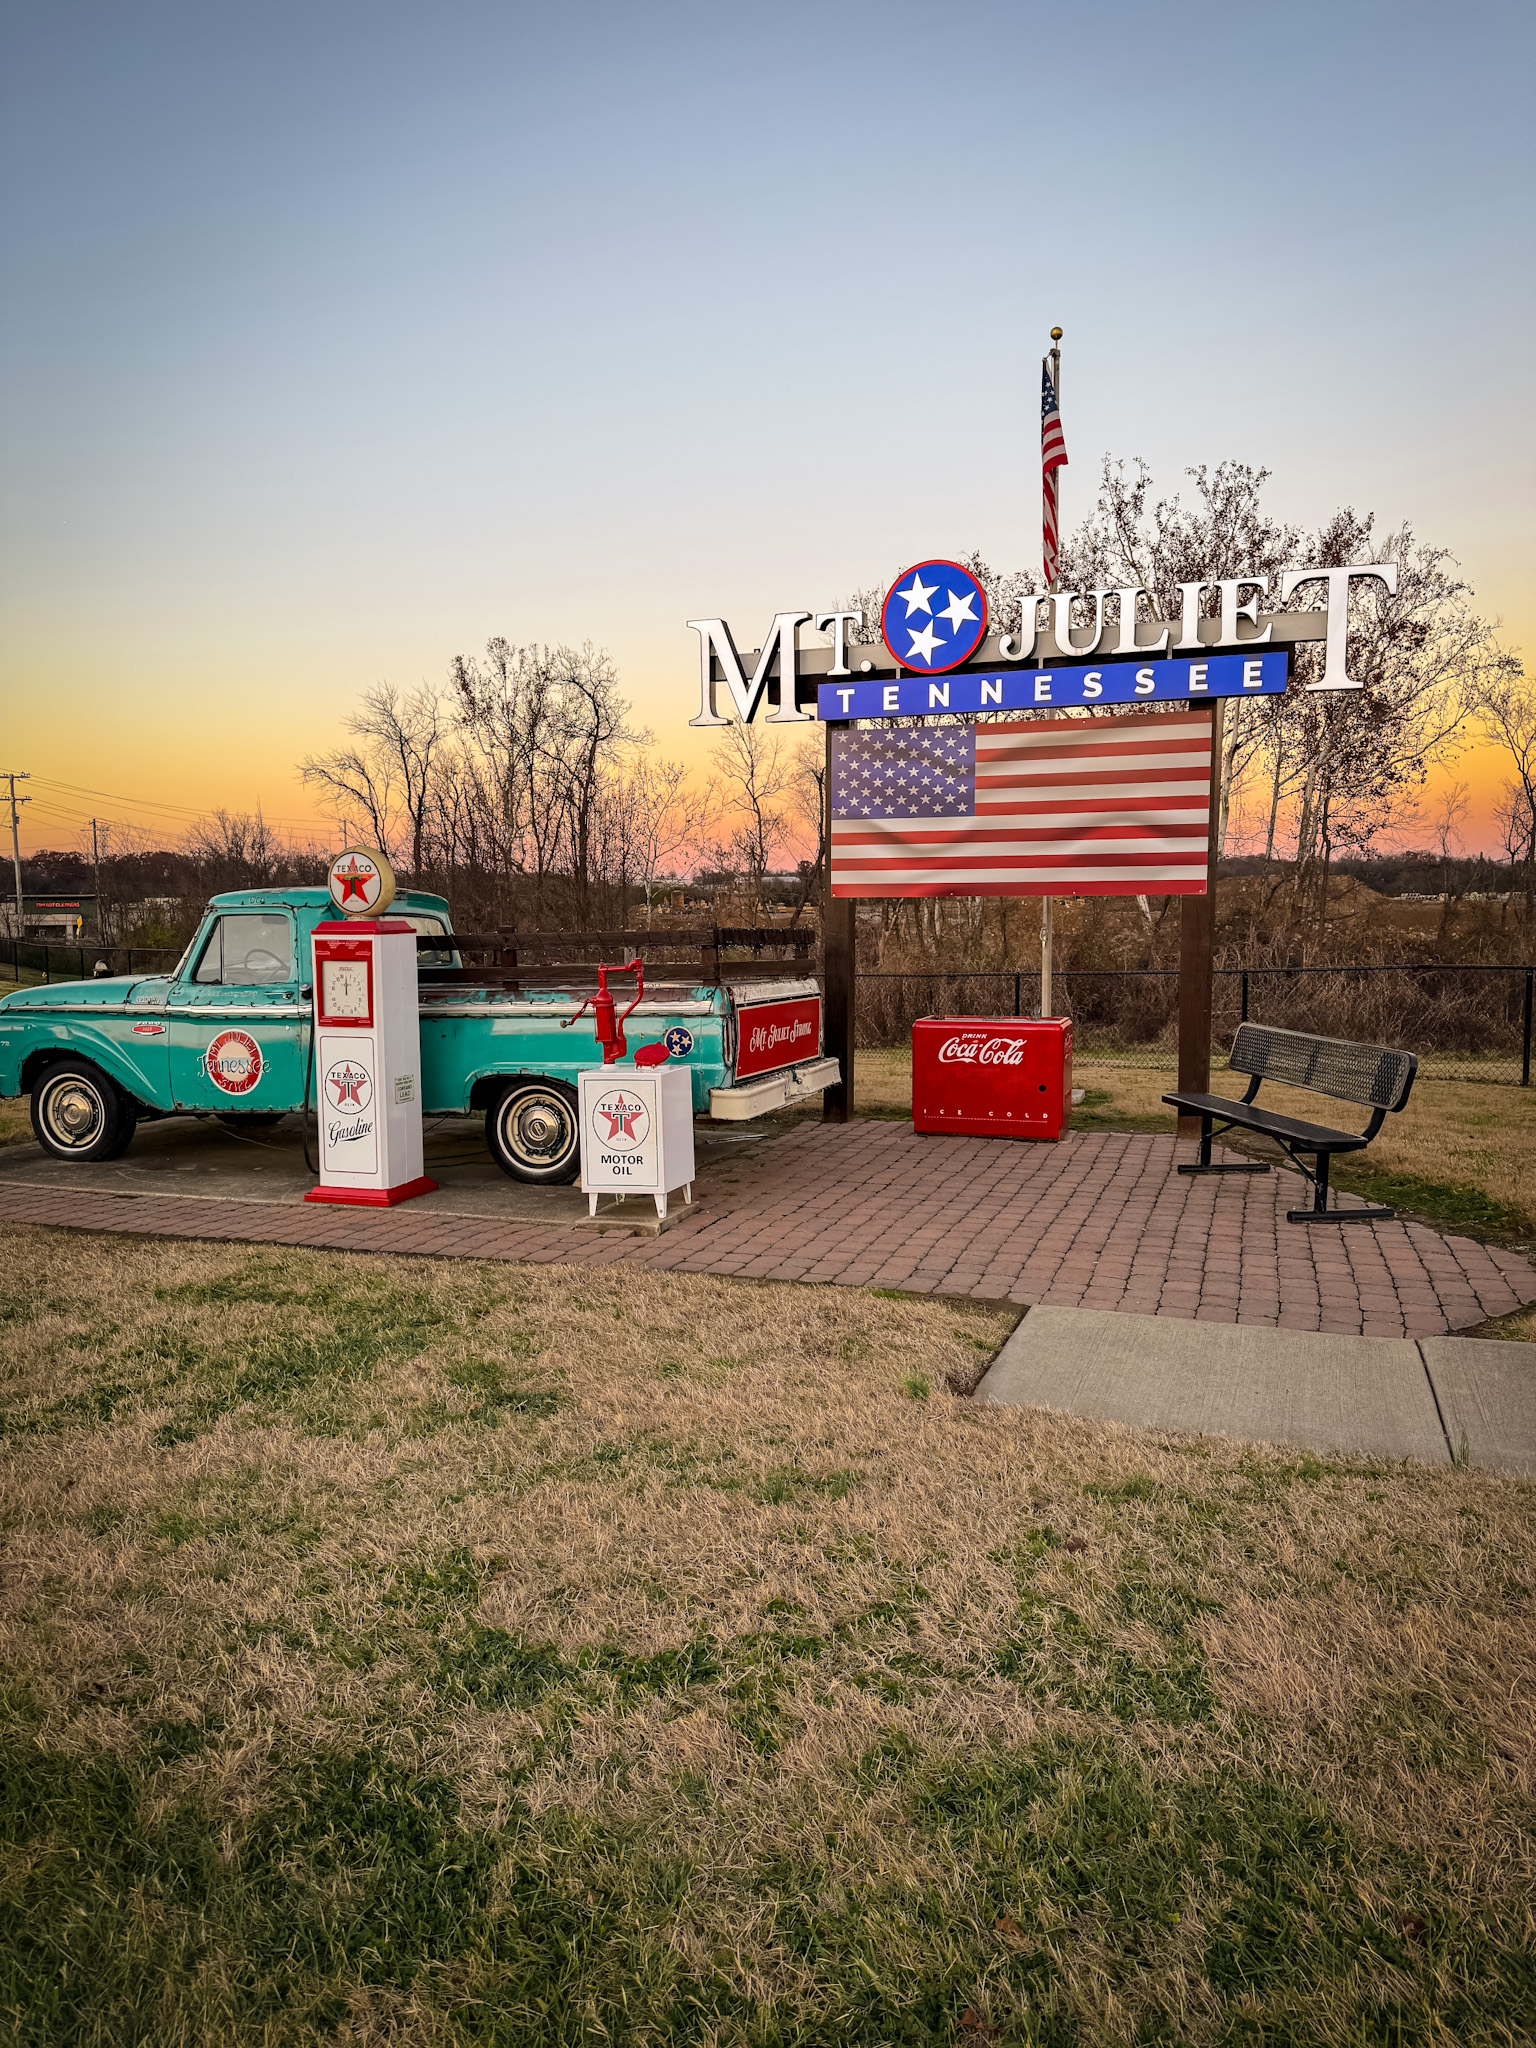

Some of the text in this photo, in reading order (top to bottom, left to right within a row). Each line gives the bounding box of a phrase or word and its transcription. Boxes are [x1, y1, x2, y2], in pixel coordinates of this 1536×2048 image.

[998, 562, 1400, 692] JULIET
[836, 660, 1265, 714] TENNESSEE
[336, 864, 372, 873] TEXACO
[767, 1024, 791, 1049] JULIET
[789, 1018, 812, 1043] STRONG
[961, 1033, 988, 1041] DRINK
[937, 1036, 1027, 1066] Coca-Cola
[196, 1053, 272, 1078] Tennessee
[331, 1071, 366, 1080] TEXACO
[600, 1103, 642, 1112] TEXACO
[923, 1108, 1049, 1119] ICE COLD
[328, 1117, 374, 1148] Gasoline
[600, 1154, 644, 1165] MOTOR
[612, 1165, 633, 1176] OIL
